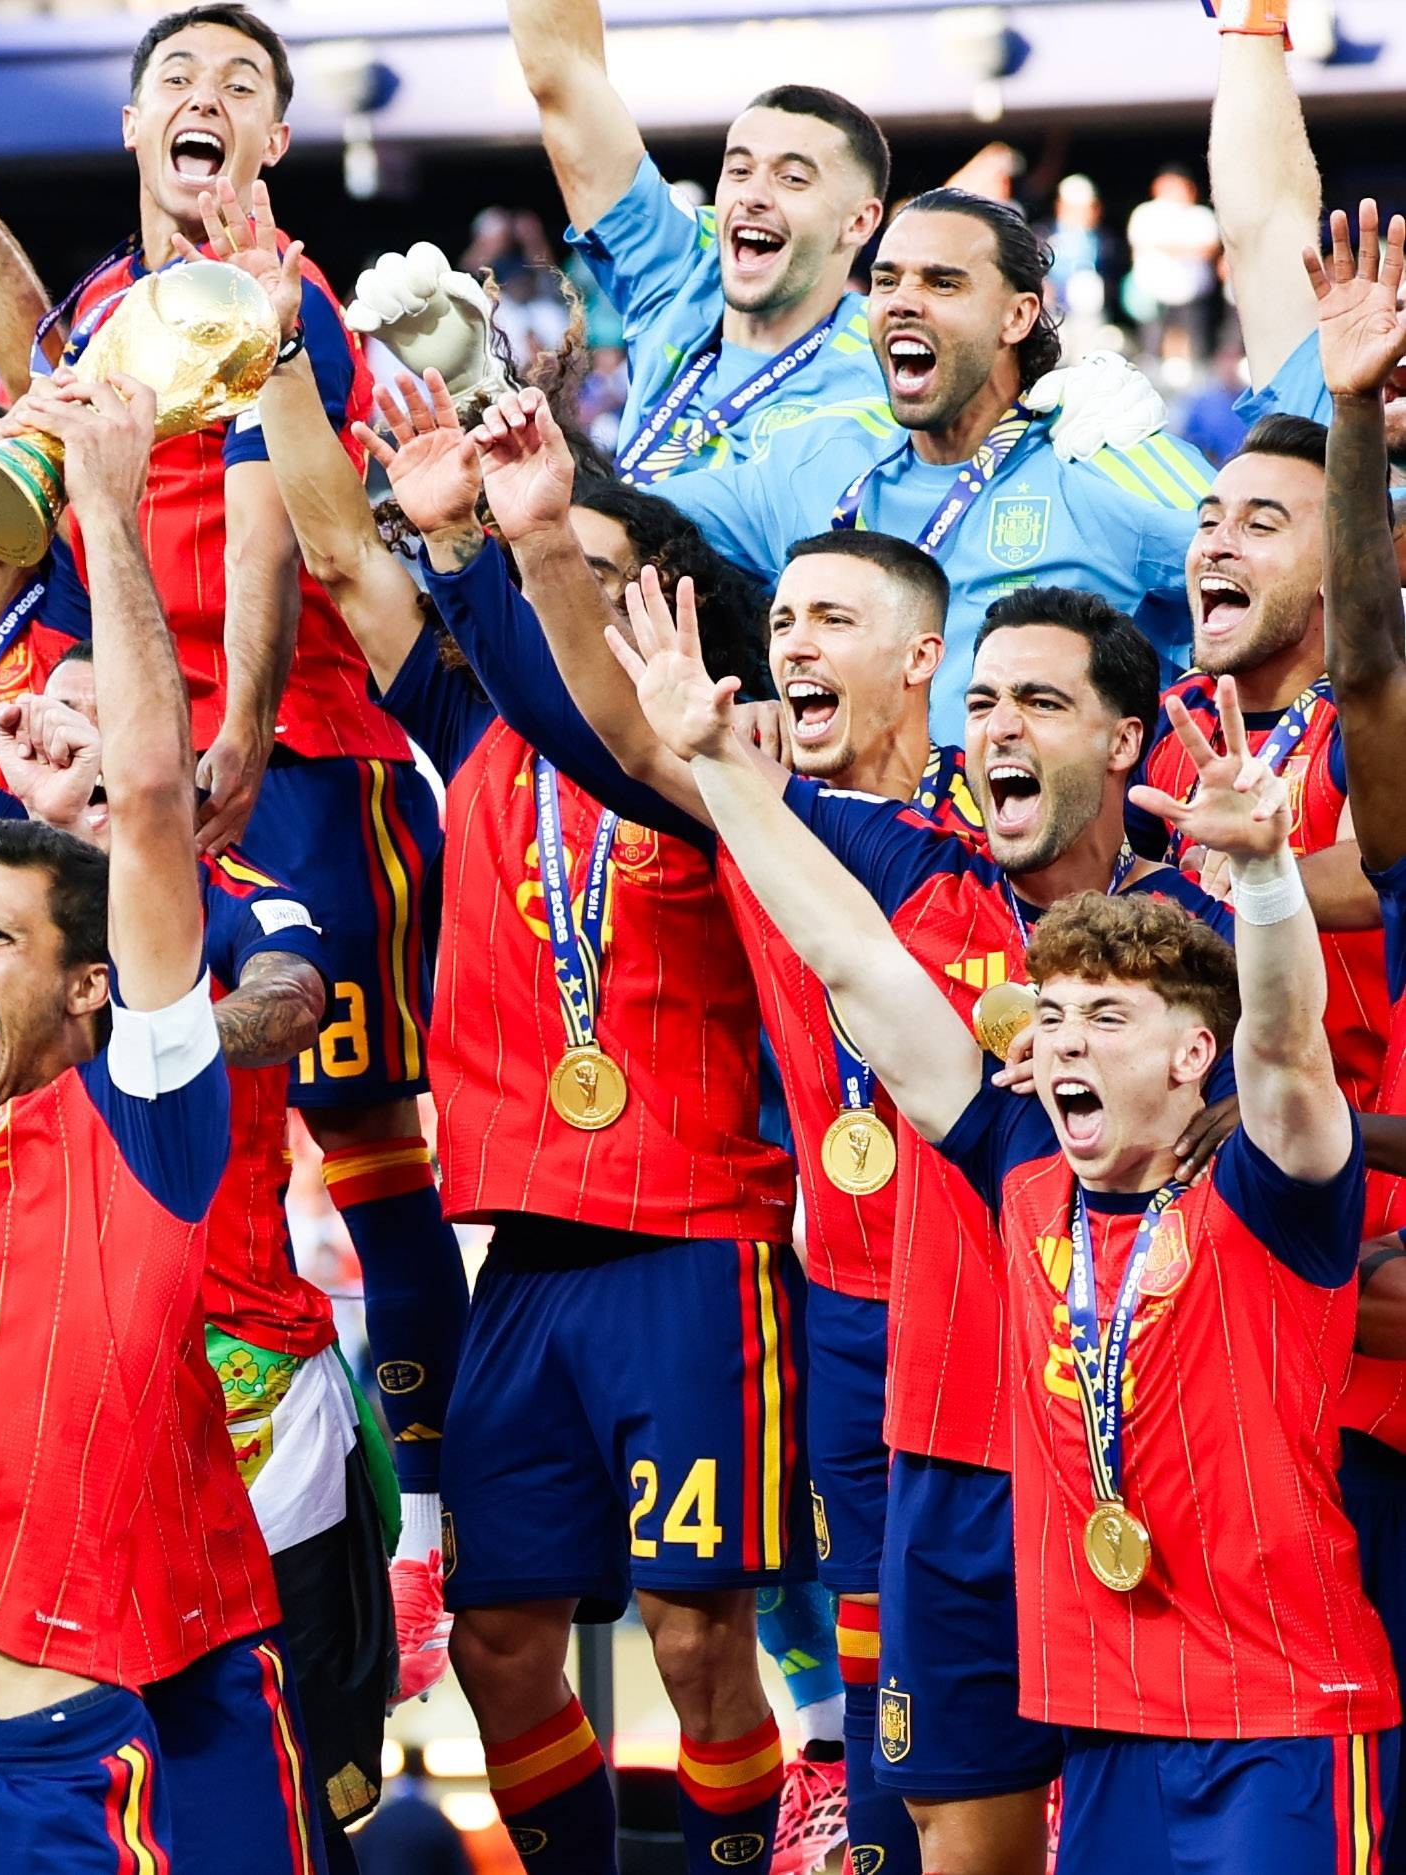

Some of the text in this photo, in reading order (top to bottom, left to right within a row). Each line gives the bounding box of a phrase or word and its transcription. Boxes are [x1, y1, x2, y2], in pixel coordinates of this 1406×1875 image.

[730, 325, 831, 409] WORLD CUP 2026
[620, 352, 716, 470] FIFA WORLD CUP 2026
[926, 498, 964, 547] 2026
[14, 583, 45, 615] 2026
[539, 772, 569, 944] FIFA WORLD CUP 2026
[587, 809, 616, 920] FIFA WORLD CU
[846, 1076, 862, 1108] 26
[1071, 1224, 1083, 1250] CUP
[1073, 1252, 1088, 1309] 2026
[1106, 1252, 1147, 1440] FIFA WORLD CUP 2026
[629, 1458, 723, 1558] 24
